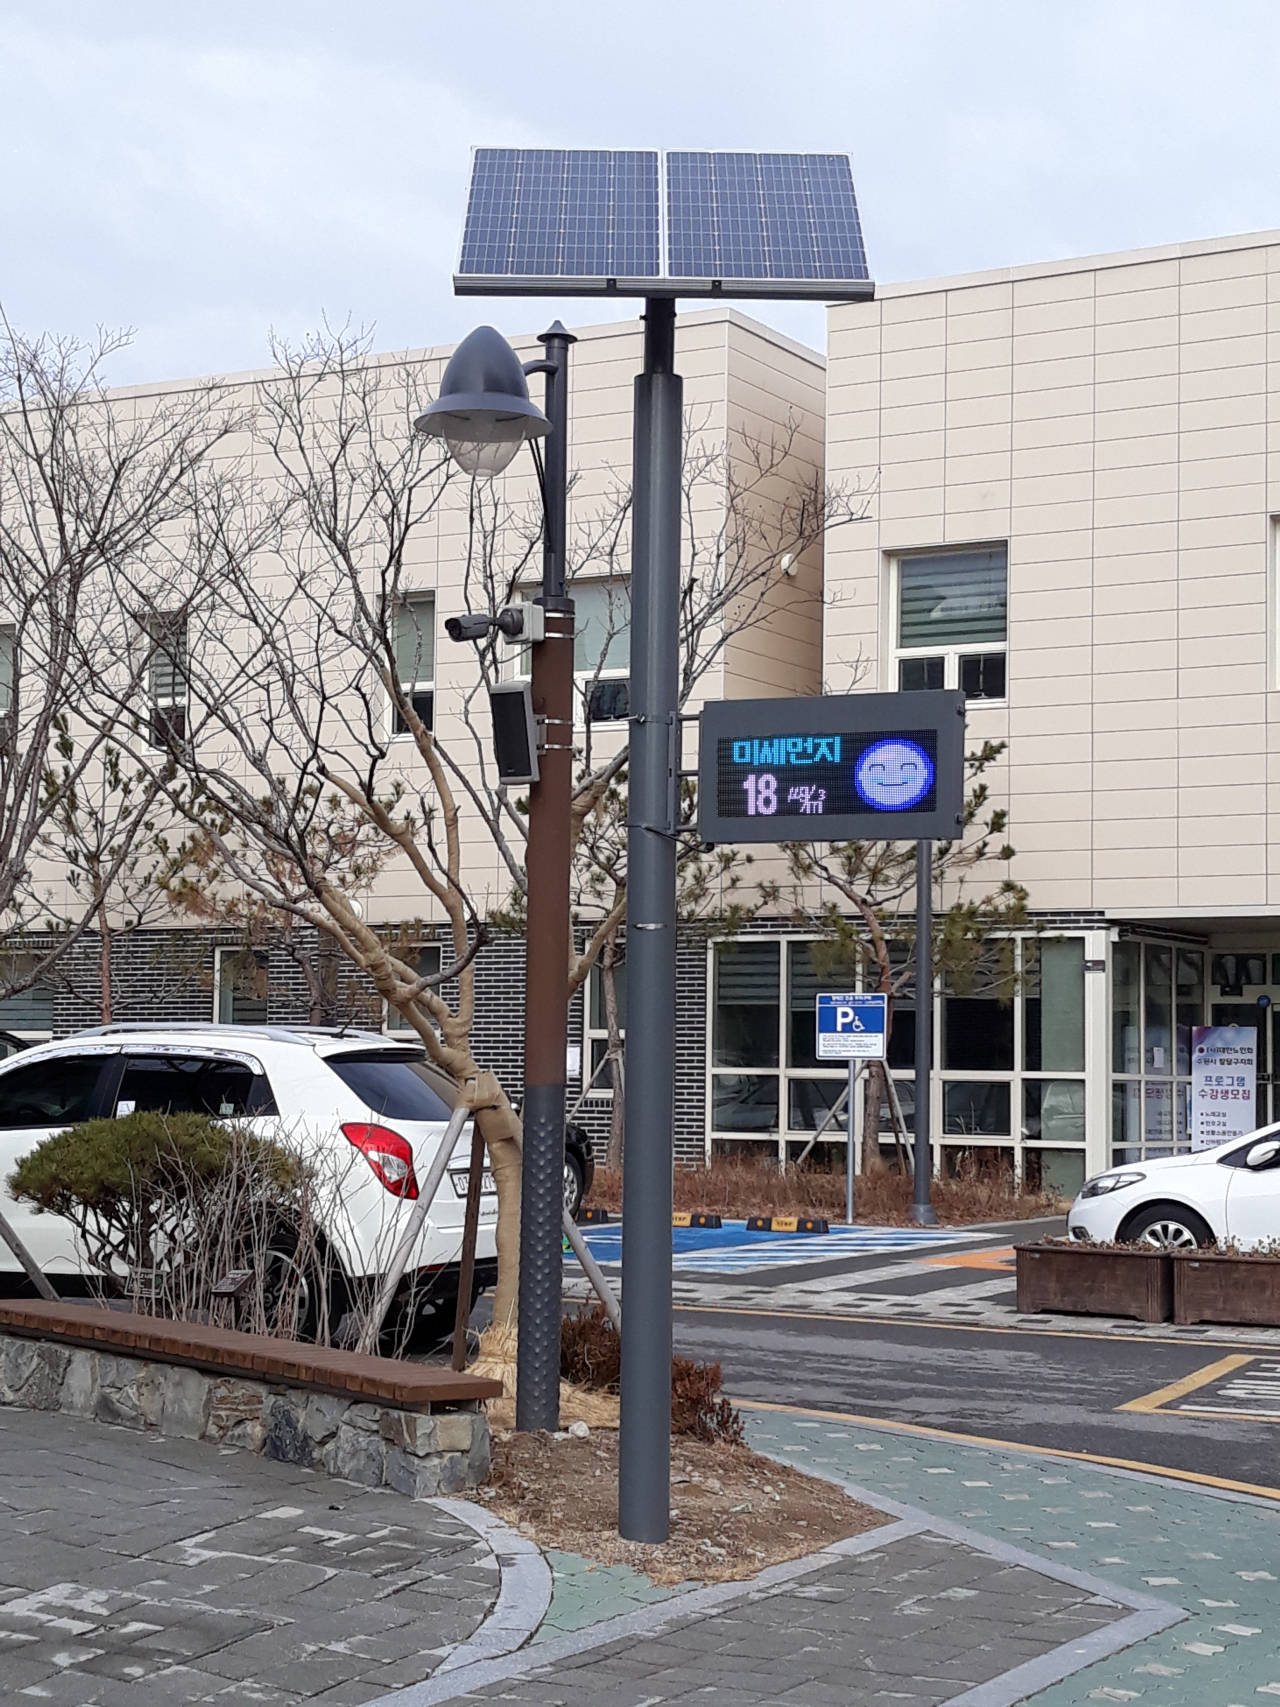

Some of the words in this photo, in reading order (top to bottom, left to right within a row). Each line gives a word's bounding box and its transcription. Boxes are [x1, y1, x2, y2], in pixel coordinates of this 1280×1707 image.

[733, 736, 841, 766] 미세먼지
[743, 773, 777, 815] 18
[836, 1006, 854, 1032] P
[1198, 1088, 1251, 1100] 수강생모집
[1204, 1075, 1246, 1087] 프로그램
